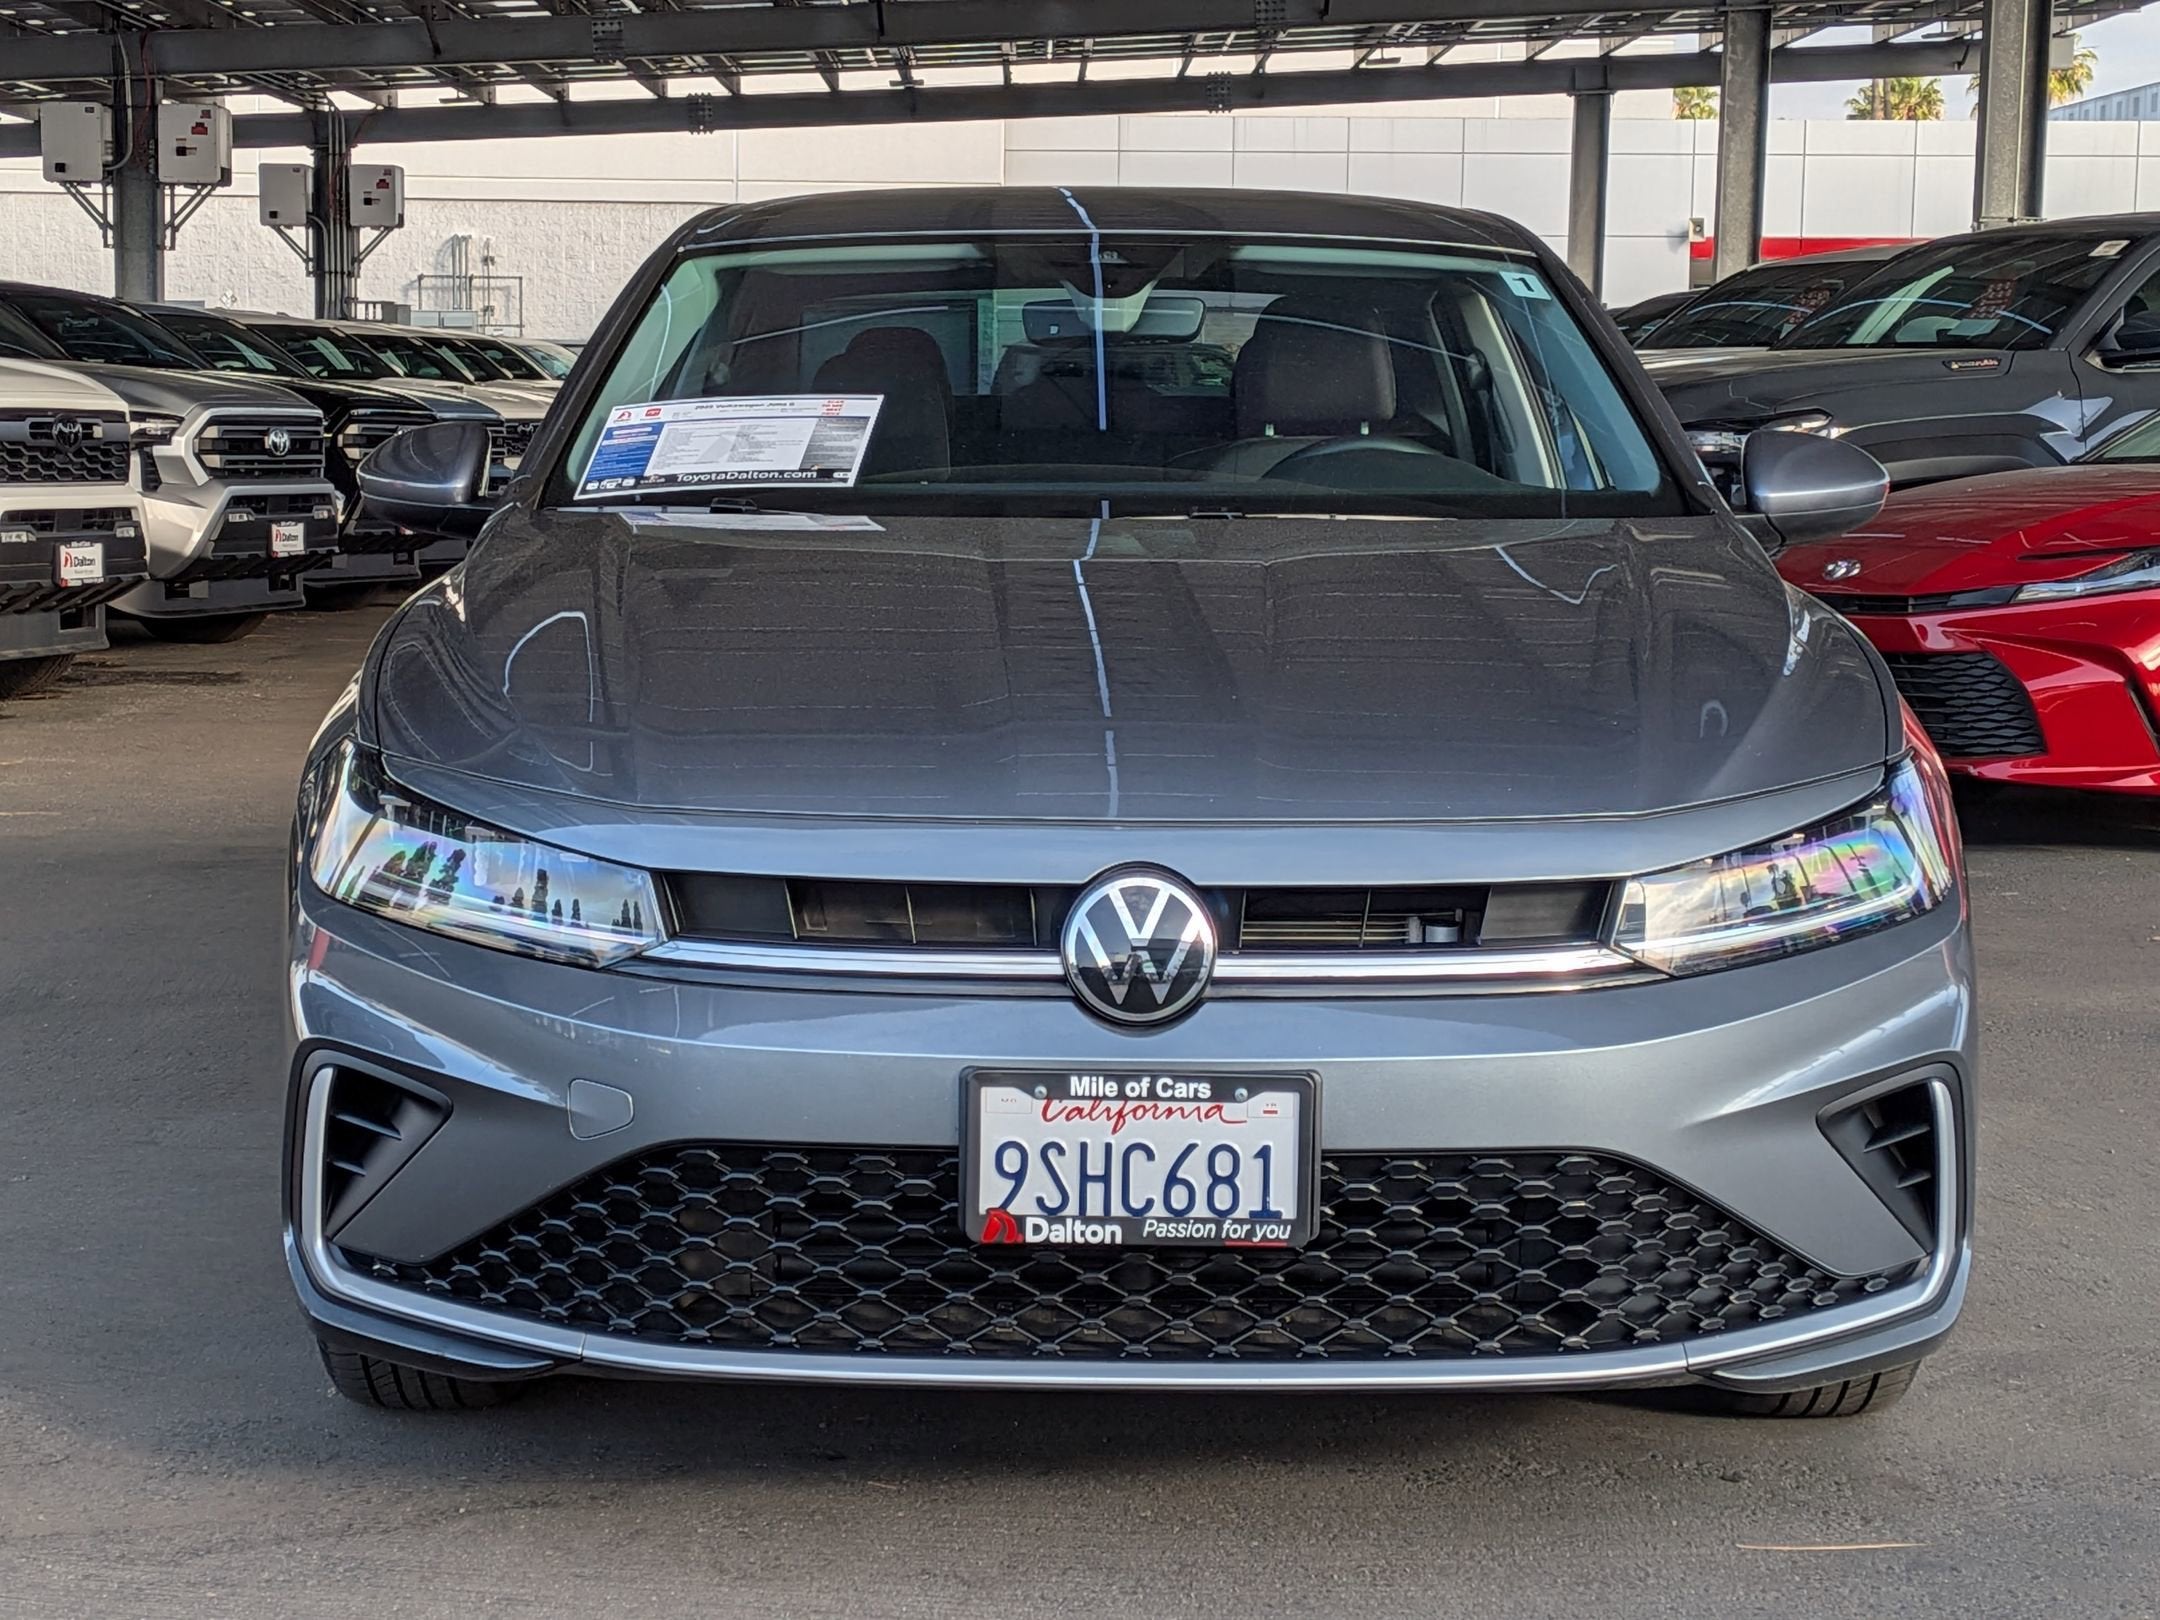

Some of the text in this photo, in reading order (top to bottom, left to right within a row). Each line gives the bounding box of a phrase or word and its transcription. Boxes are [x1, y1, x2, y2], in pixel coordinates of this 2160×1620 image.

[676, 470, 817, 483] ToyotaDalton.com
[1070, 1076, 1211, 1099] Mile of Cars
[1041, 1098, 1247, 1135] California
[994, 1140, 1283, 1220] 9SHC681
[1025, 1217, 1122, 1244] Dalton
[1143, 1219, 1291, 1241] Passion for you
